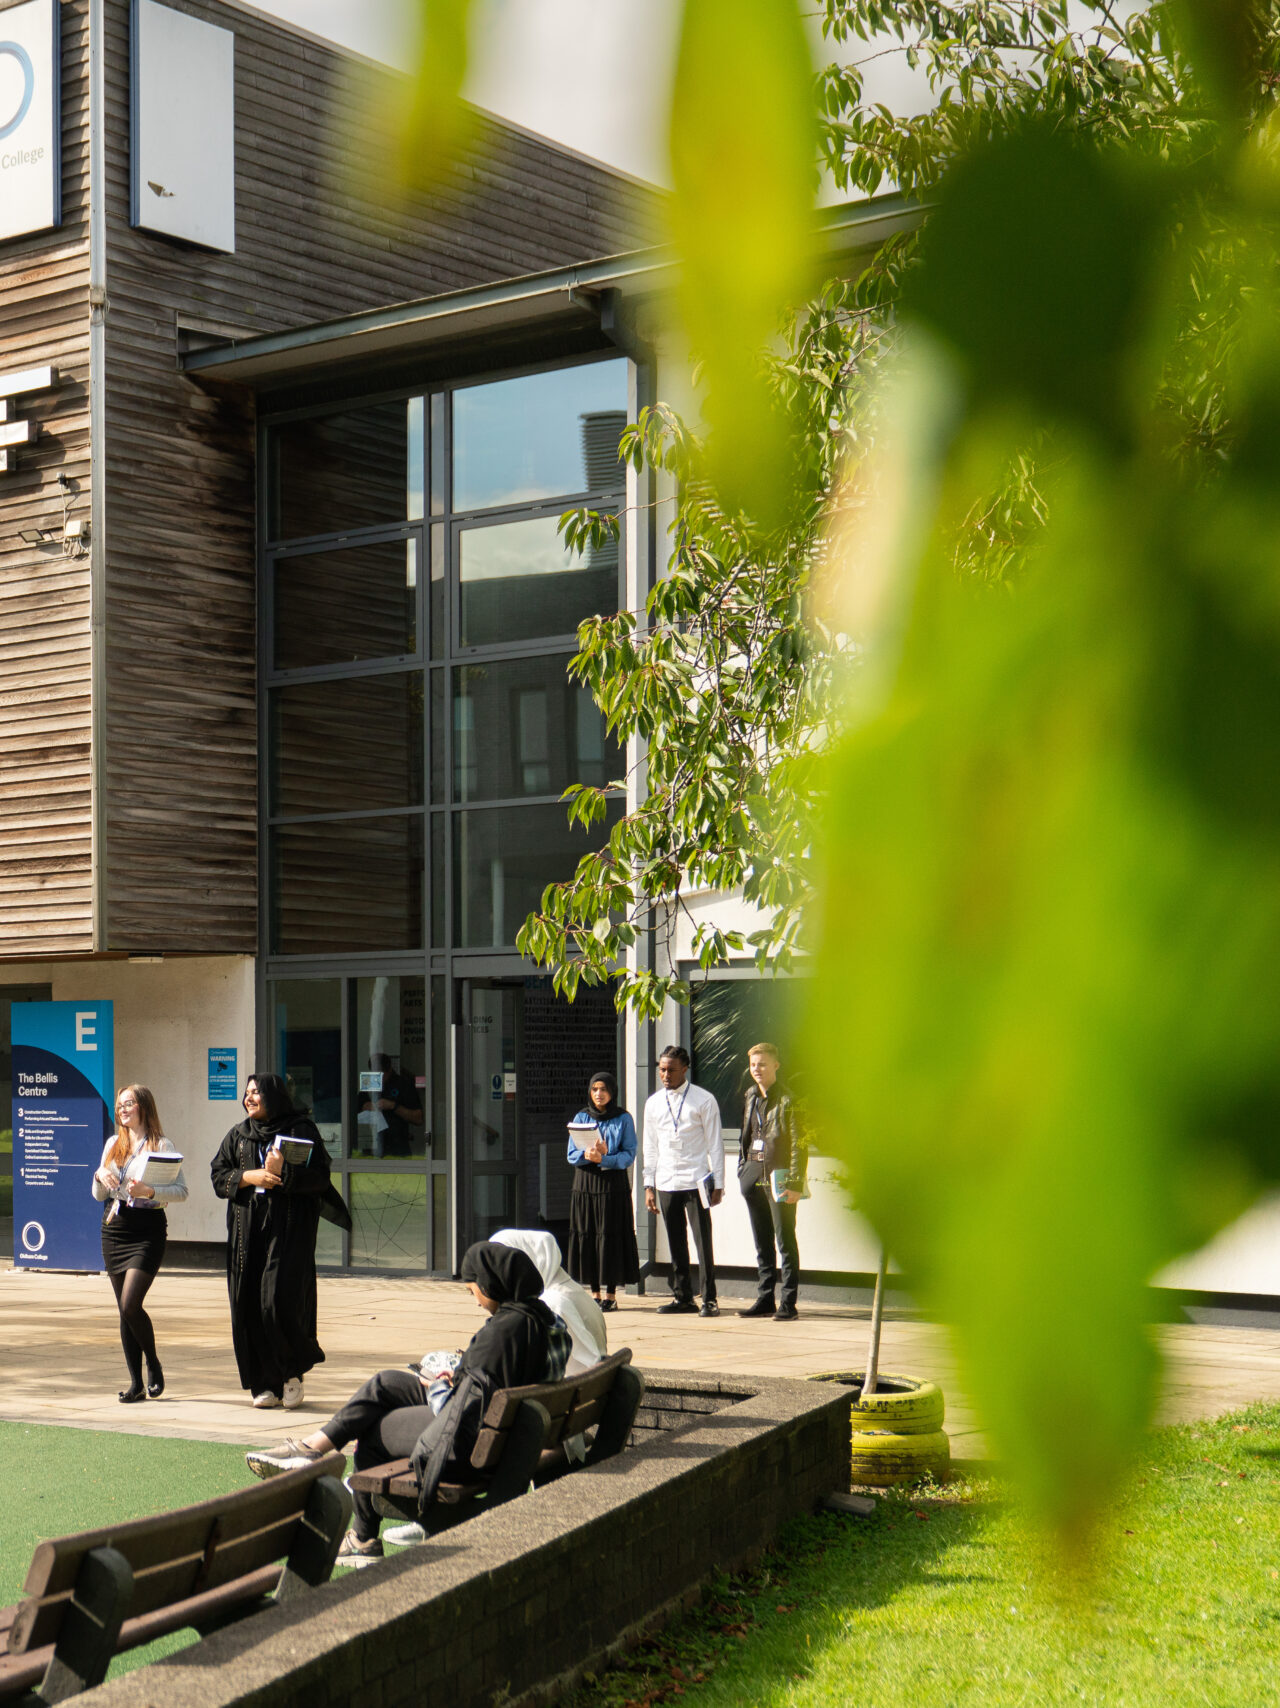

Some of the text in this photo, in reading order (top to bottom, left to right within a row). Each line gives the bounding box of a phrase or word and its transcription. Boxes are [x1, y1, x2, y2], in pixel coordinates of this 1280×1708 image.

[1, 147, 44, 169] College
[76, 1012, 97, 1051] E
[18, 1073, 58, 1083] The Bellis
[18, 1086, 48, 1096] Centre
[18, 1108, 23, 1117] 3
[19, 1128, 24, 1137] 2
[20, 1168, 24, 1176] 1
[34, 1253, 48, 1261] College
